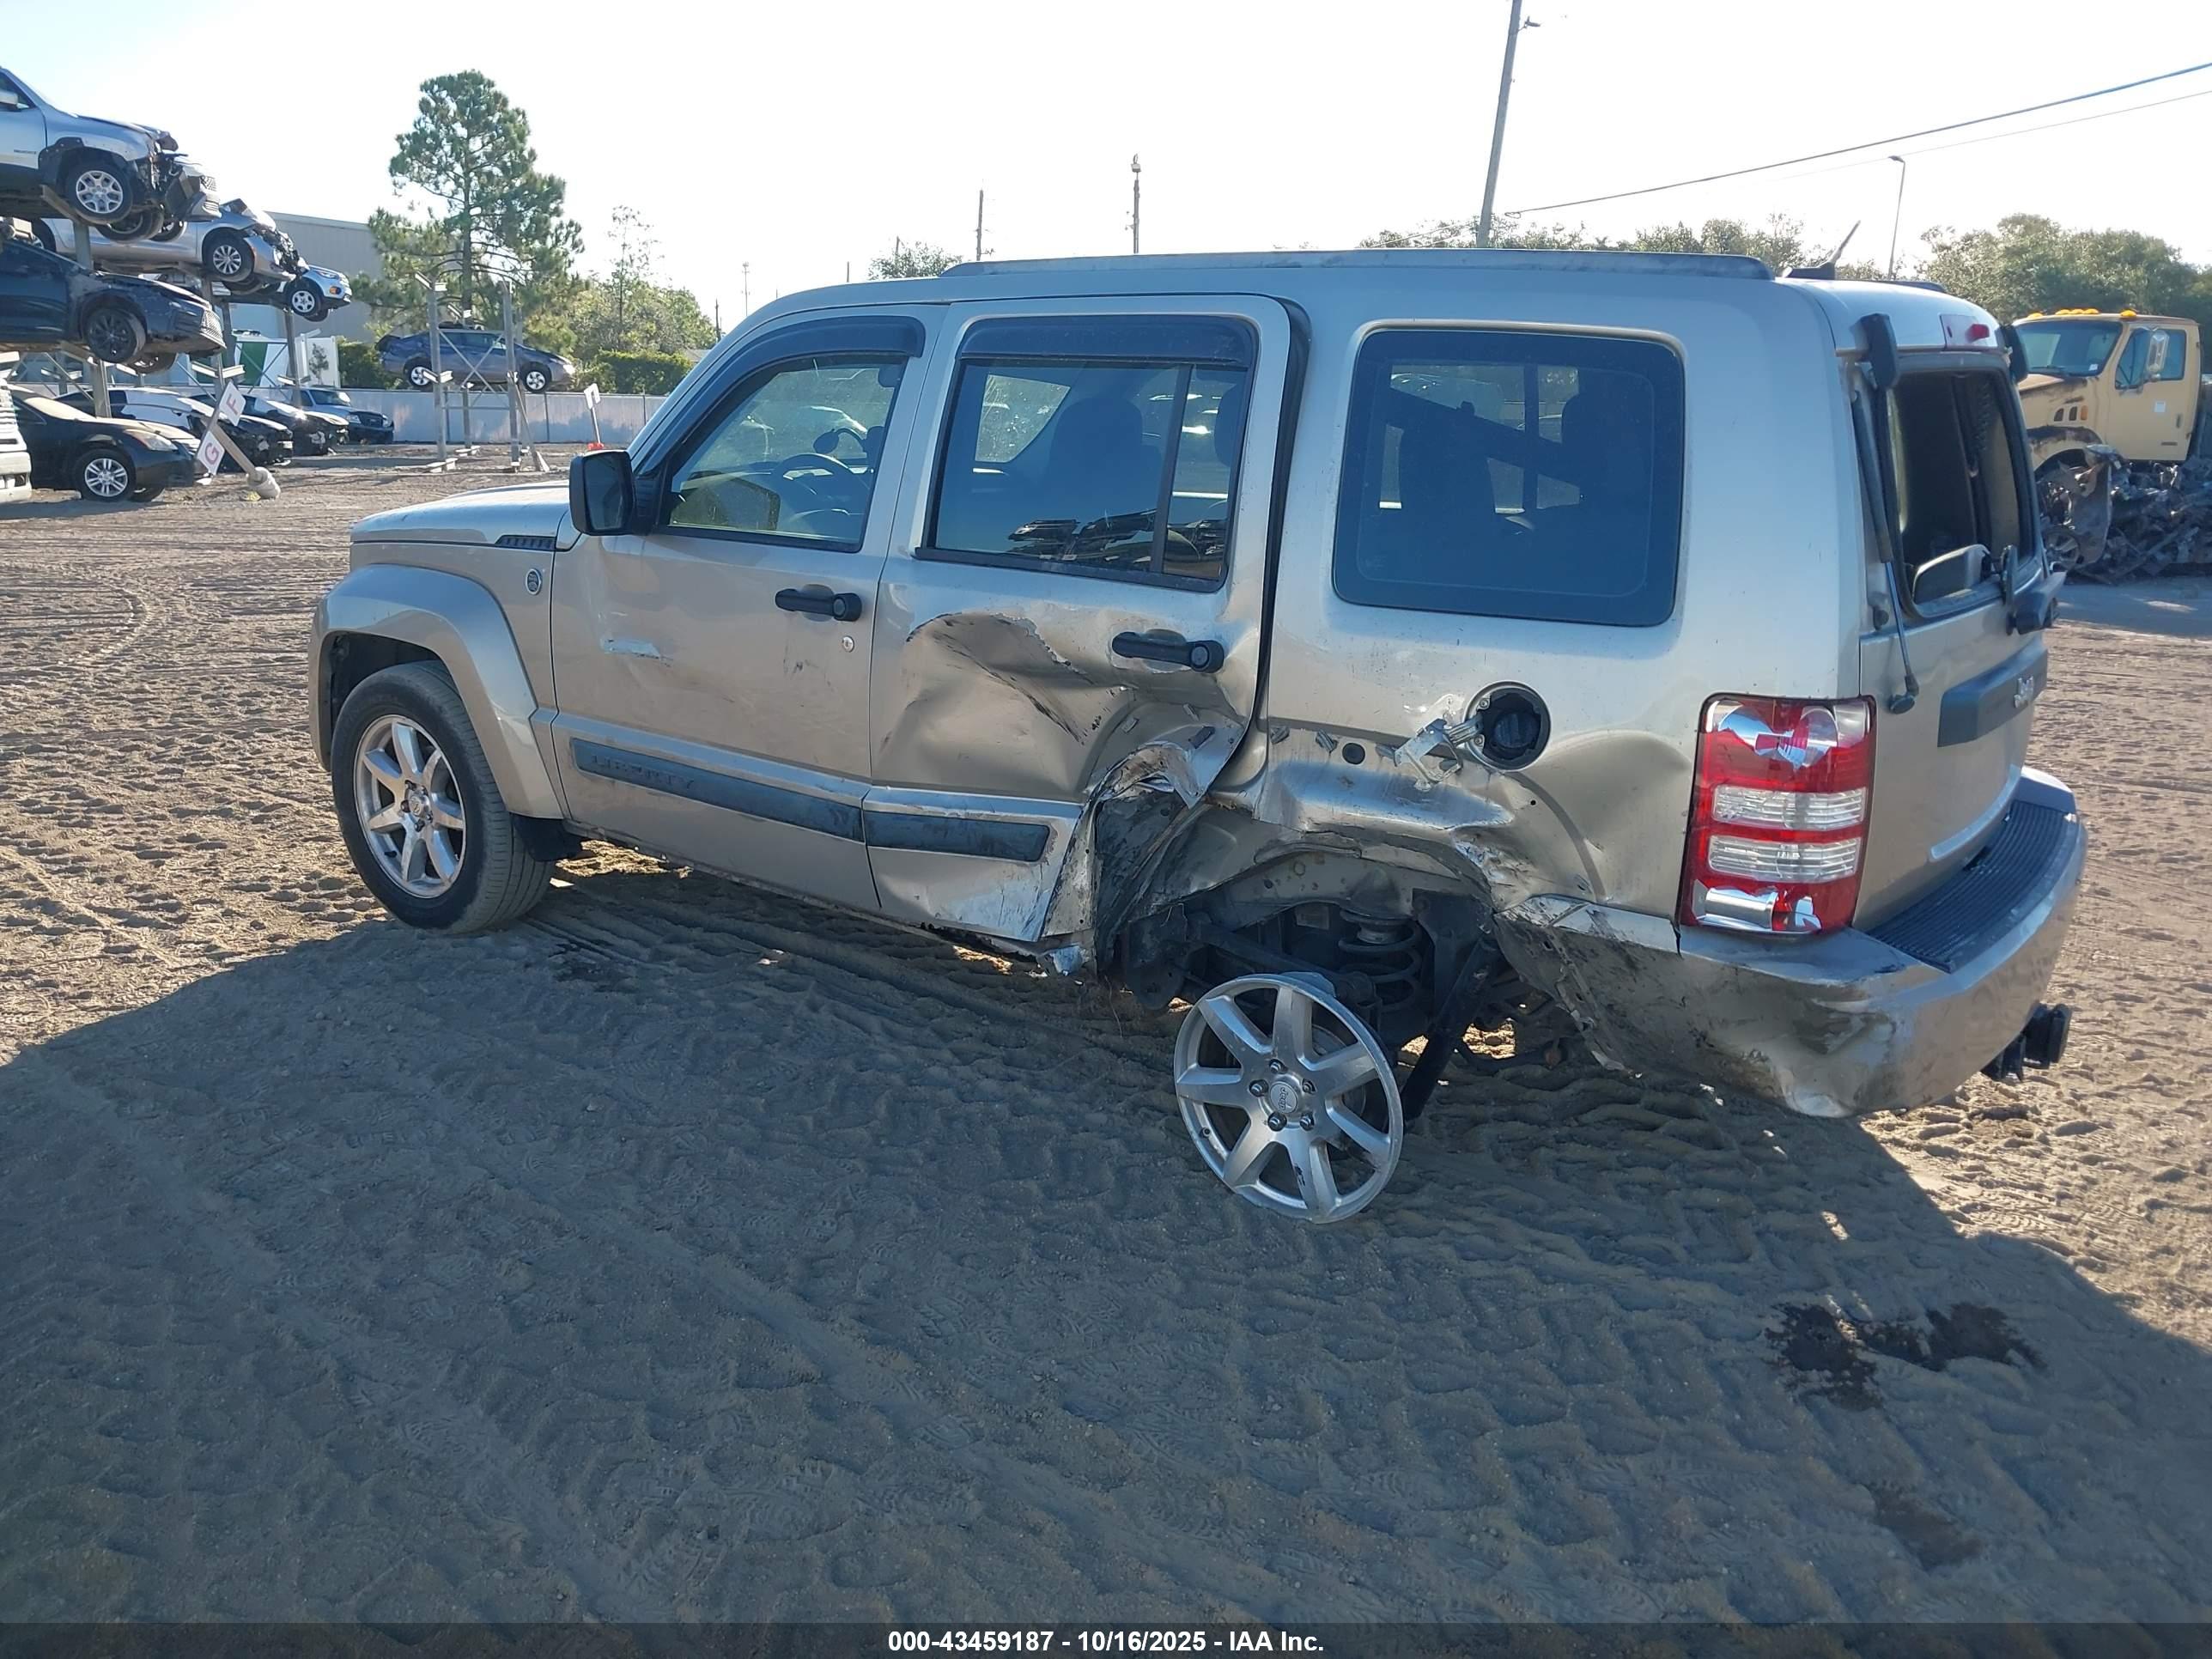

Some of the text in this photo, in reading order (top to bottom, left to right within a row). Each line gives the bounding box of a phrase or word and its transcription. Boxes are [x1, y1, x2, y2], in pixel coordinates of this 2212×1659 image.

[226, 393, 239, 416] F
[205, 442, 220, 465] G
[1278, 1086, 1289, 1111] Jeep
